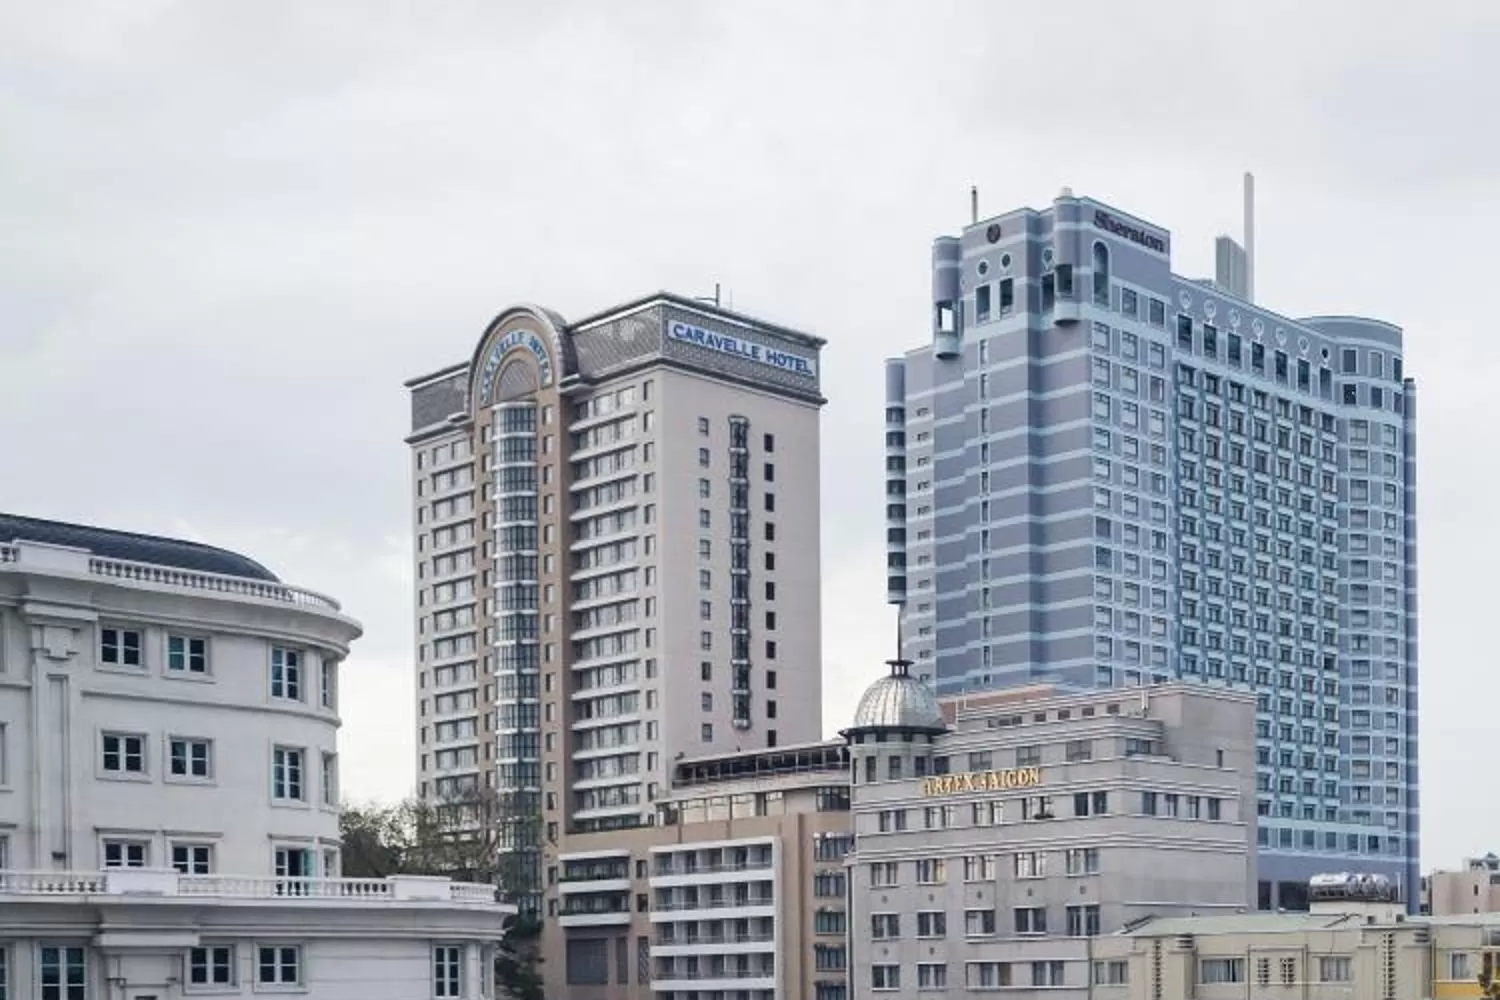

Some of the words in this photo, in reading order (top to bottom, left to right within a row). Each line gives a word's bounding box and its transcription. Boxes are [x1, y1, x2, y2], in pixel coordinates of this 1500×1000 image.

[1094, 210, 1164, 252] Sheraton
[673, 324, 760, 359] CARAVELLE
[766, 350, 813, 375] HOTEL
[979, 767, 1039, 791] SAIGON
